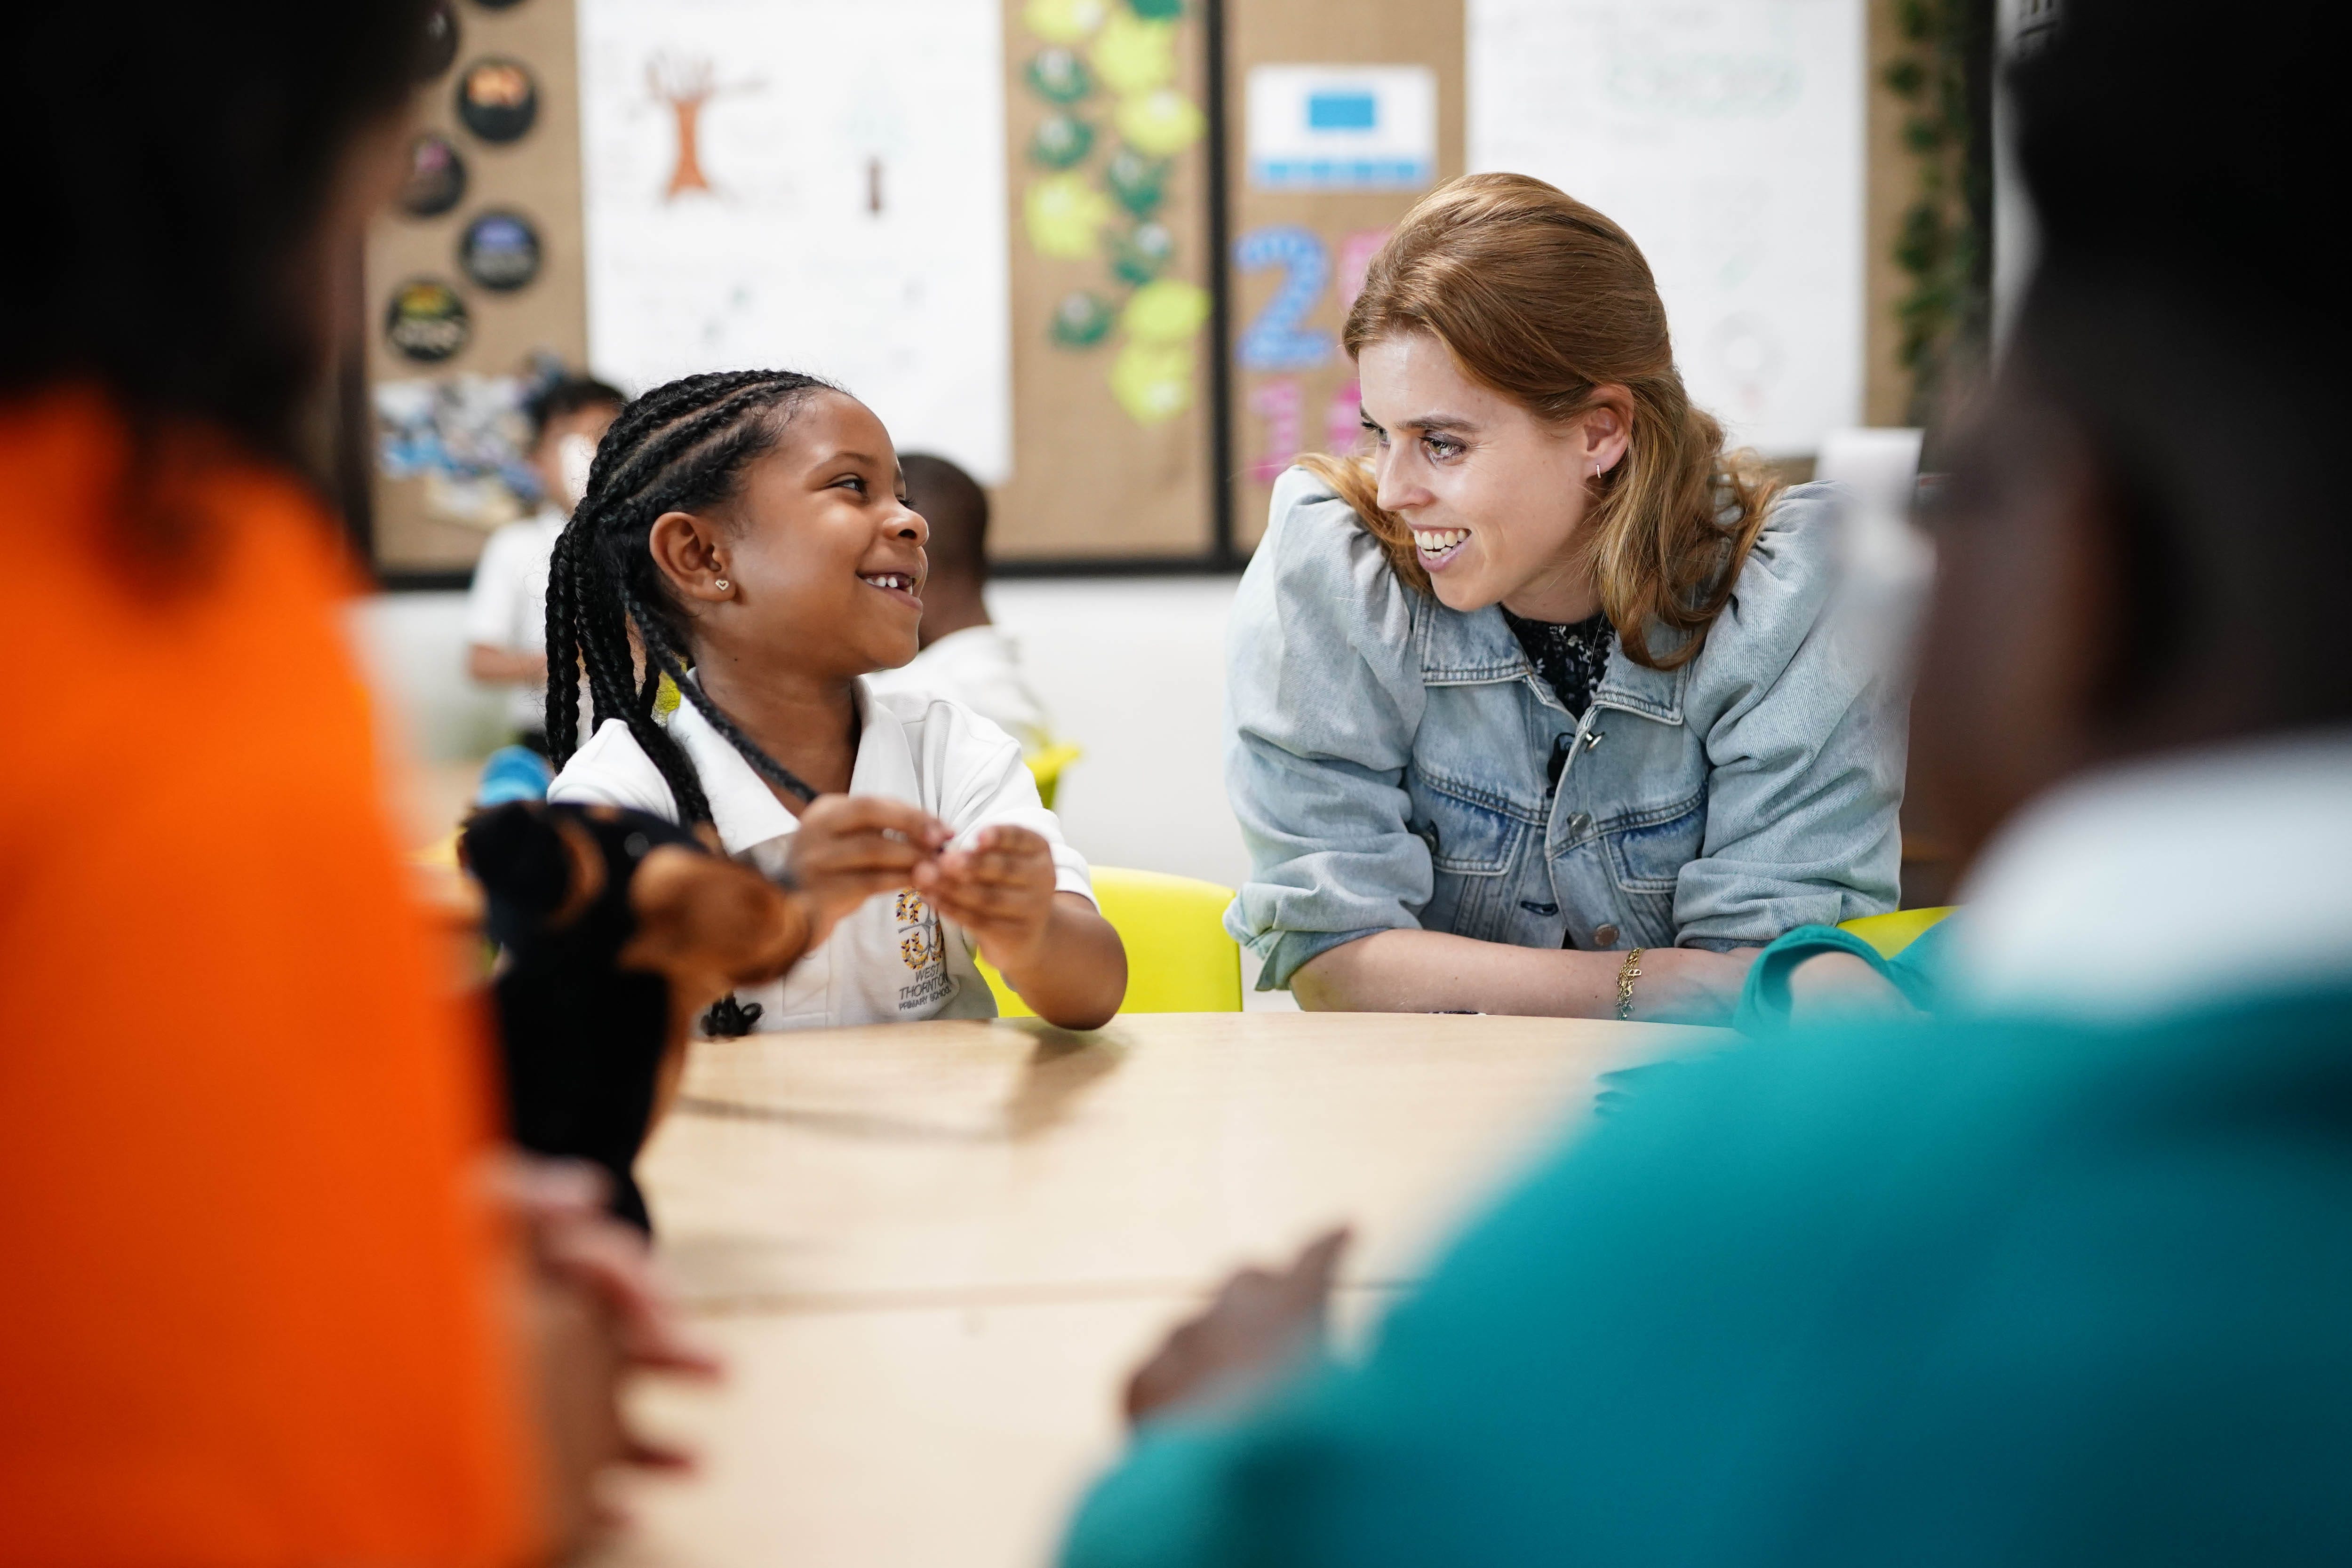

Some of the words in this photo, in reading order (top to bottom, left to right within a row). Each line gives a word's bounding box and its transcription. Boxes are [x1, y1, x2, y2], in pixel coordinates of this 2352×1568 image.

[915, 963, 941, 982] WEST
[899, 971, 949, 1000] THORNTON
[899, 995, 928, 1011] PRIMARY
